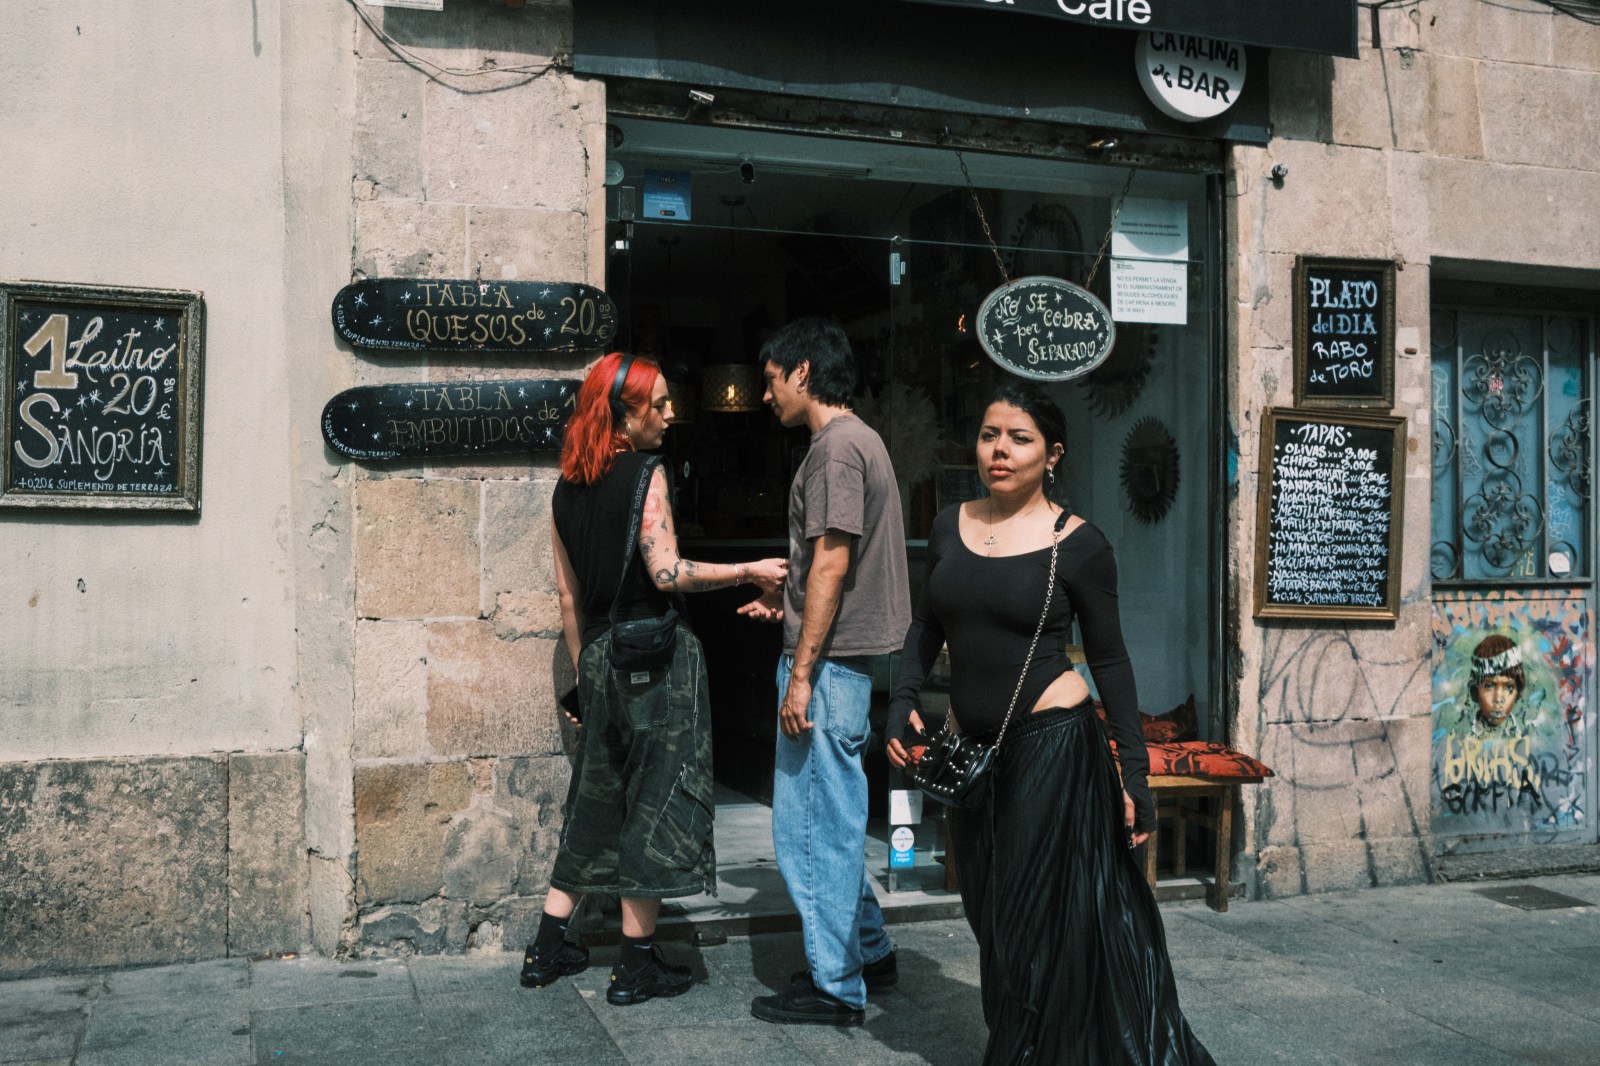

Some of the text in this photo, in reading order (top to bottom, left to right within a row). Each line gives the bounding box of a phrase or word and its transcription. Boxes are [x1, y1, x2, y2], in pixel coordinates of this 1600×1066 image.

[1178, 64, 1230, 104] BAR
[417, 283, 514, 308] TABLA
[1310, 277, 1378, 309] PLATO
[996, 293, 1048, 319] NO SE
[406, 309, 526, 345] QUESOS
[527, 303, 545, 320] de
[560, 297, 595, 336] 20
[1312, 313, 1333, 334] del
[1013, 323, 1041, 347] por
[23, 314, 78, 389] 1
[1027, 337, 1096, 364] SEPARADO
[1313, 340, 1368, 359] RABO
[1310, 359, 1374, 384] de TORO
[415, 385, 513, 411] TABLA
[538, 400, 560, 420] de
[1297, 424, 1346, 446] TAPAS
[1277, 465, 1299, 479] PAN
[1313, 469, 1350, 482] TOMATE
[57, 479, 115, 491] SUPLEMENTO
[117, 483, 129, 492] DE
[130, 483, 173, 493] TERRAZA
[1273, 542, 1319, 557] HUMMUS
[1310, 580, 1343, 592] BRAVAS
